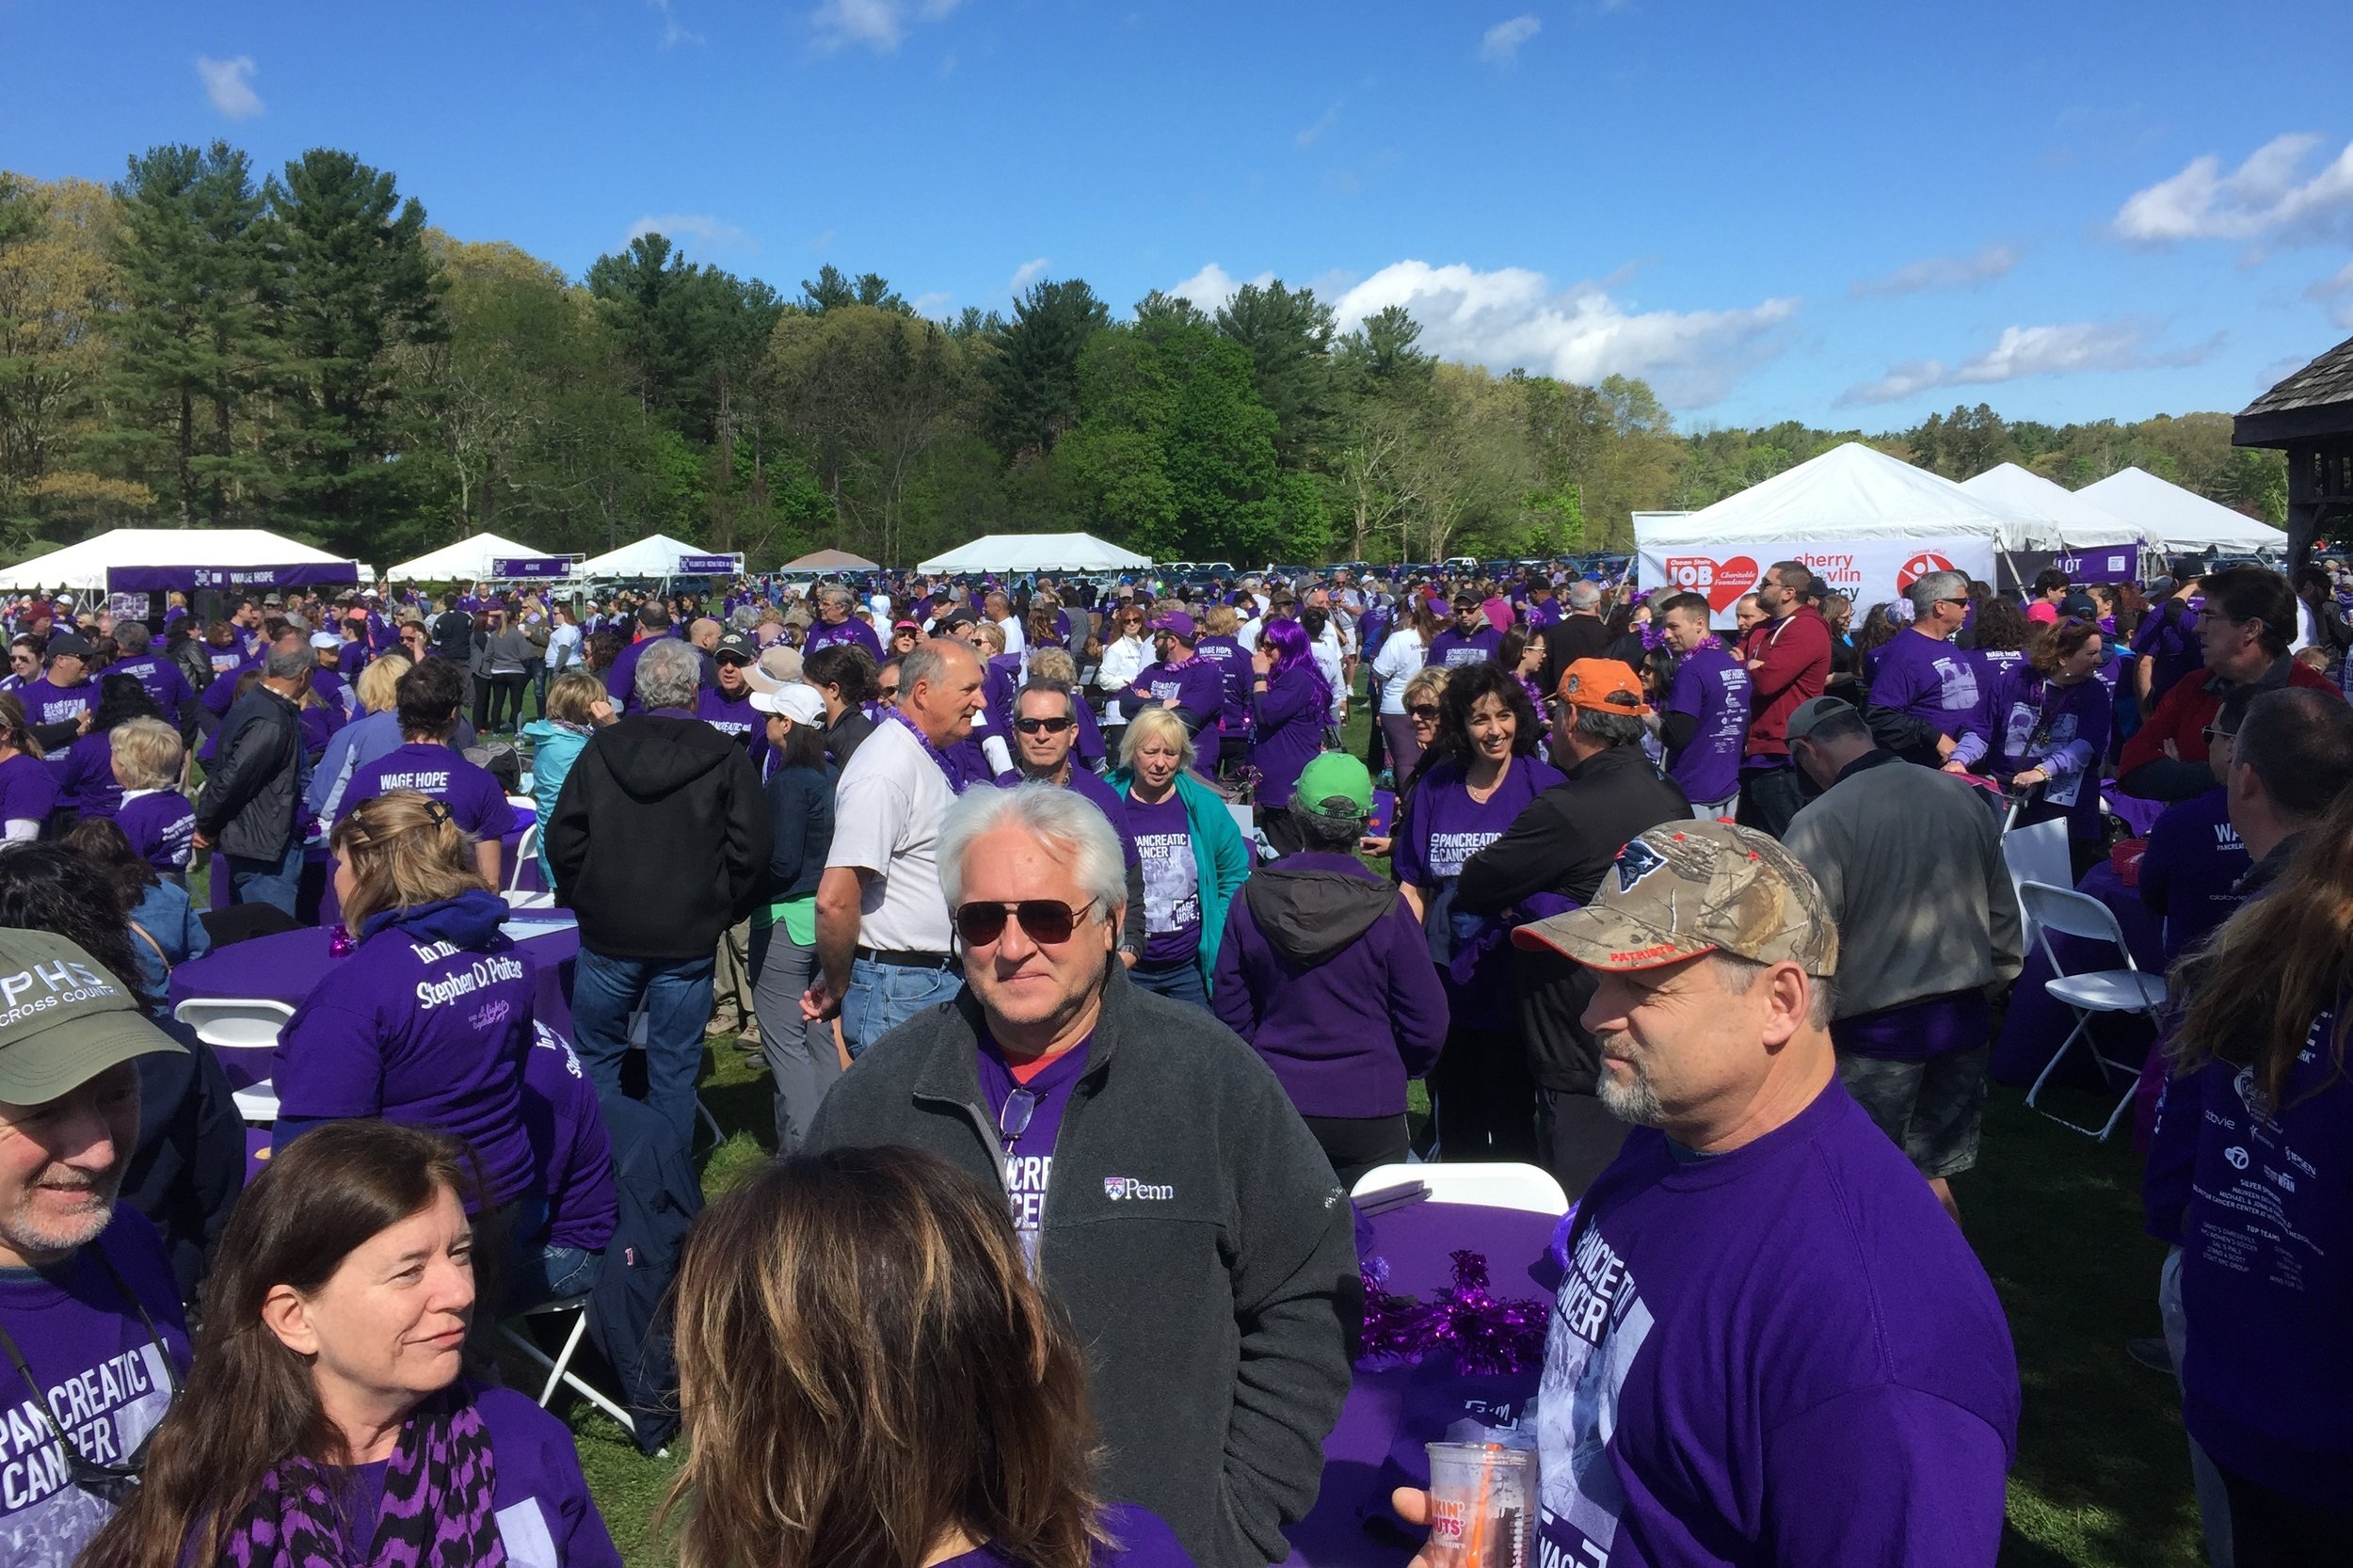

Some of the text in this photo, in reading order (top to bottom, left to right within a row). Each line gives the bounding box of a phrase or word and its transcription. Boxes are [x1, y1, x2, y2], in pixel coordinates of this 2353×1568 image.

[231, 572, 252, 584] WAGE
[253, 571, 274, 583] HOPE
[1668, 566, 1713, 586] JOB
[380, 772, 449, 790] WAGE HOPE
[1134, 833, 1187, 846] ANCREATIC
[1138, 846, 1169, 858] ANCER
[409, 944, 440, 964] In
[1609, 942, 1675, 962] PATRIOTS
[0, 959, 103, 1007] PHS
[416, 972, 476, 1010] Stephen
[472, 962, 490, 988] D.
[0, 996, 58, 1027] CROSS
[1126, 1178, 1174, 1200] Penn
[2240, 1178, 2261, 1191] SILVER
[2212, 1195, 2235, 1208] CANCER
[2235, 1204, 2259, 1216] CENTER
[2219, 1191, 2247, 1204] MICHAEL
[2247, 1224, 2281, 1242] TOP TEAMS
[2, 1416, 117, 1510] CANER
